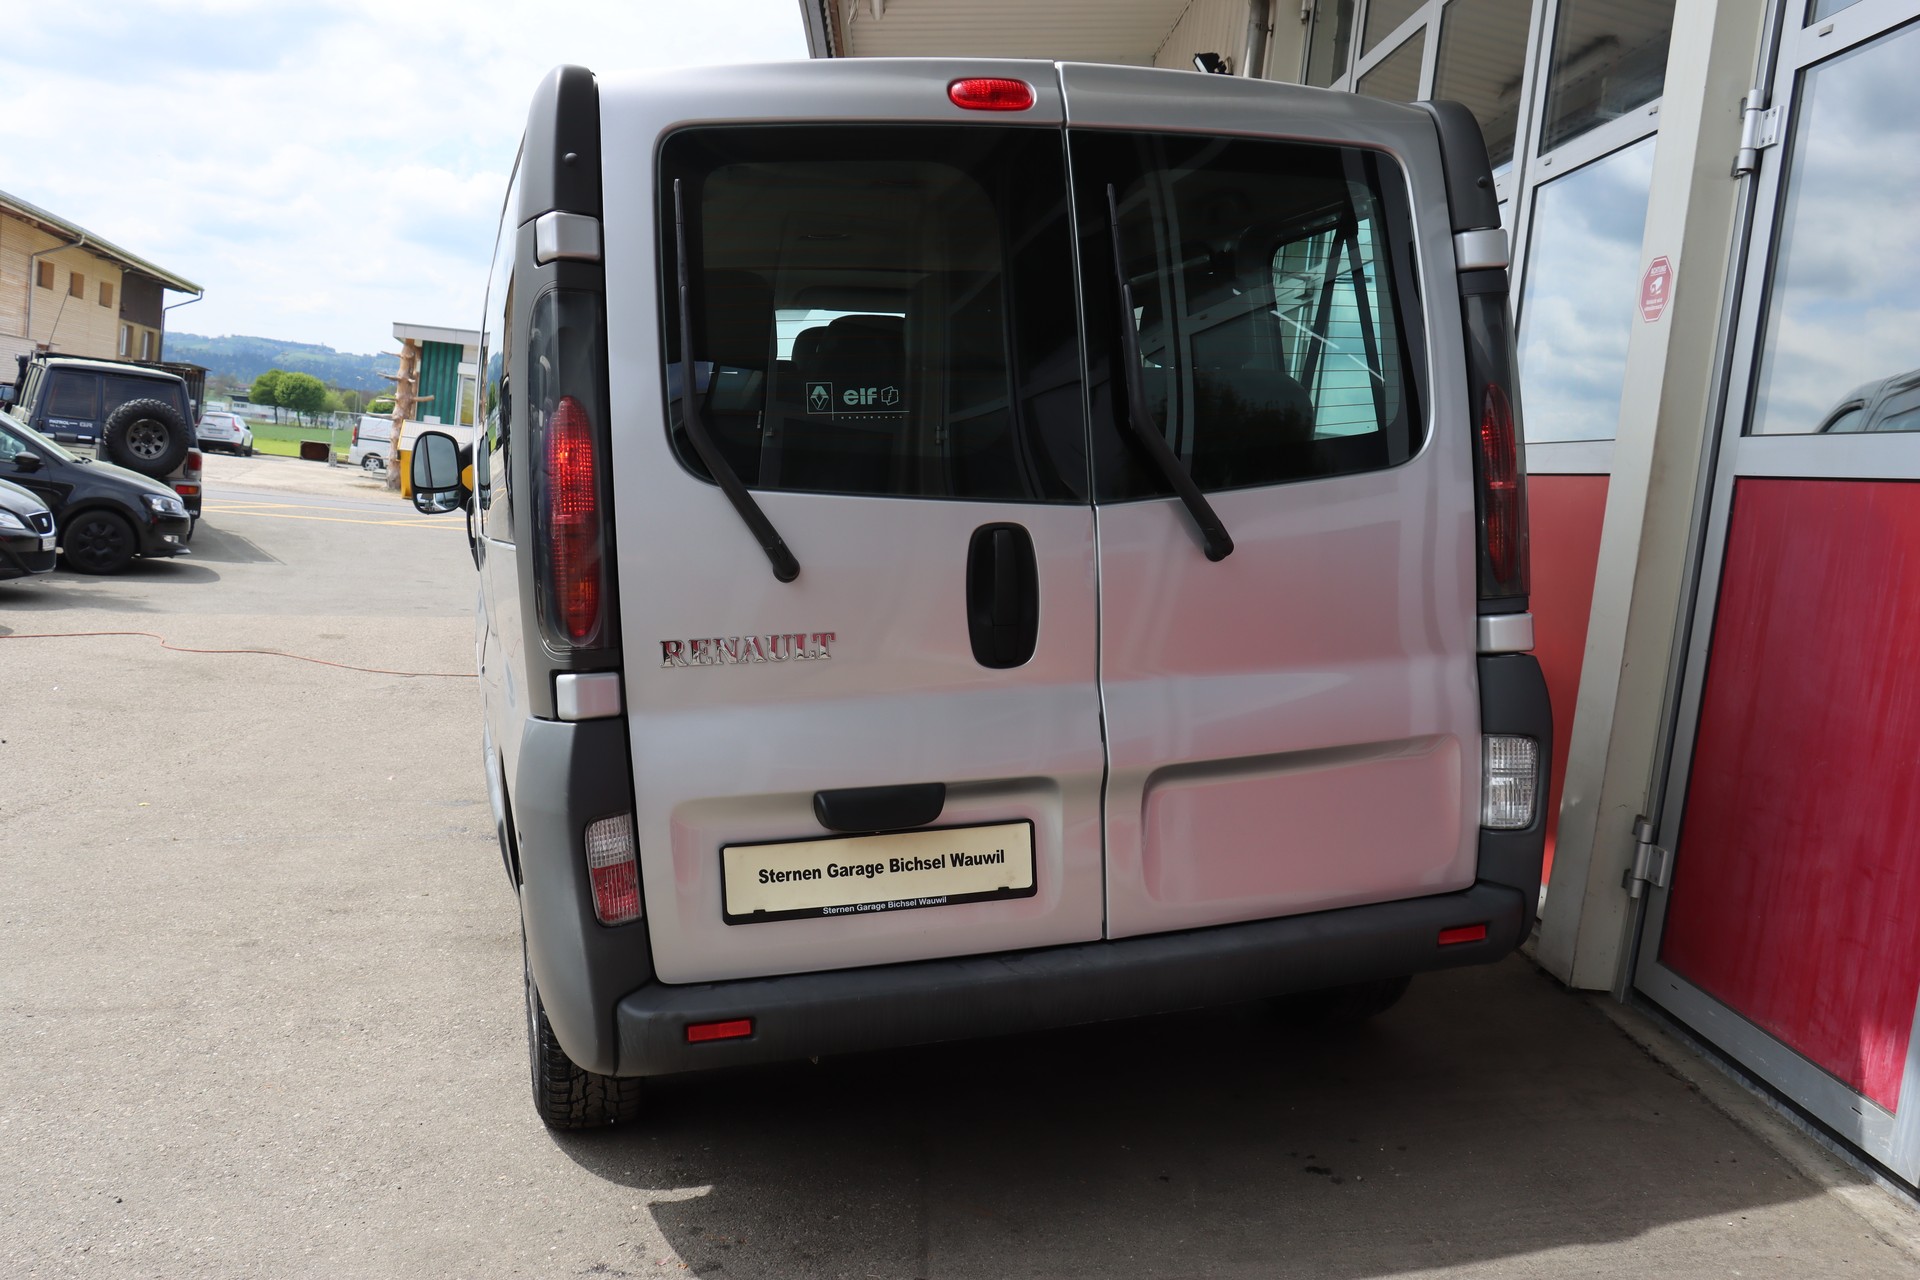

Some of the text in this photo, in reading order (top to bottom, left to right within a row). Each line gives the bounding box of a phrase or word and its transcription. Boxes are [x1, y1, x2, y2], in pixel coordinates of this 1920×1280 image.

[843, 387, 878, 405] elf
[659, 632, 837, 668] RENAULT
[758, 849, 1005, 884] Sternen Garage Bichsel Wauwil
[823, 896, 947, 915] Sternen Garage Bichsel Wauwil
